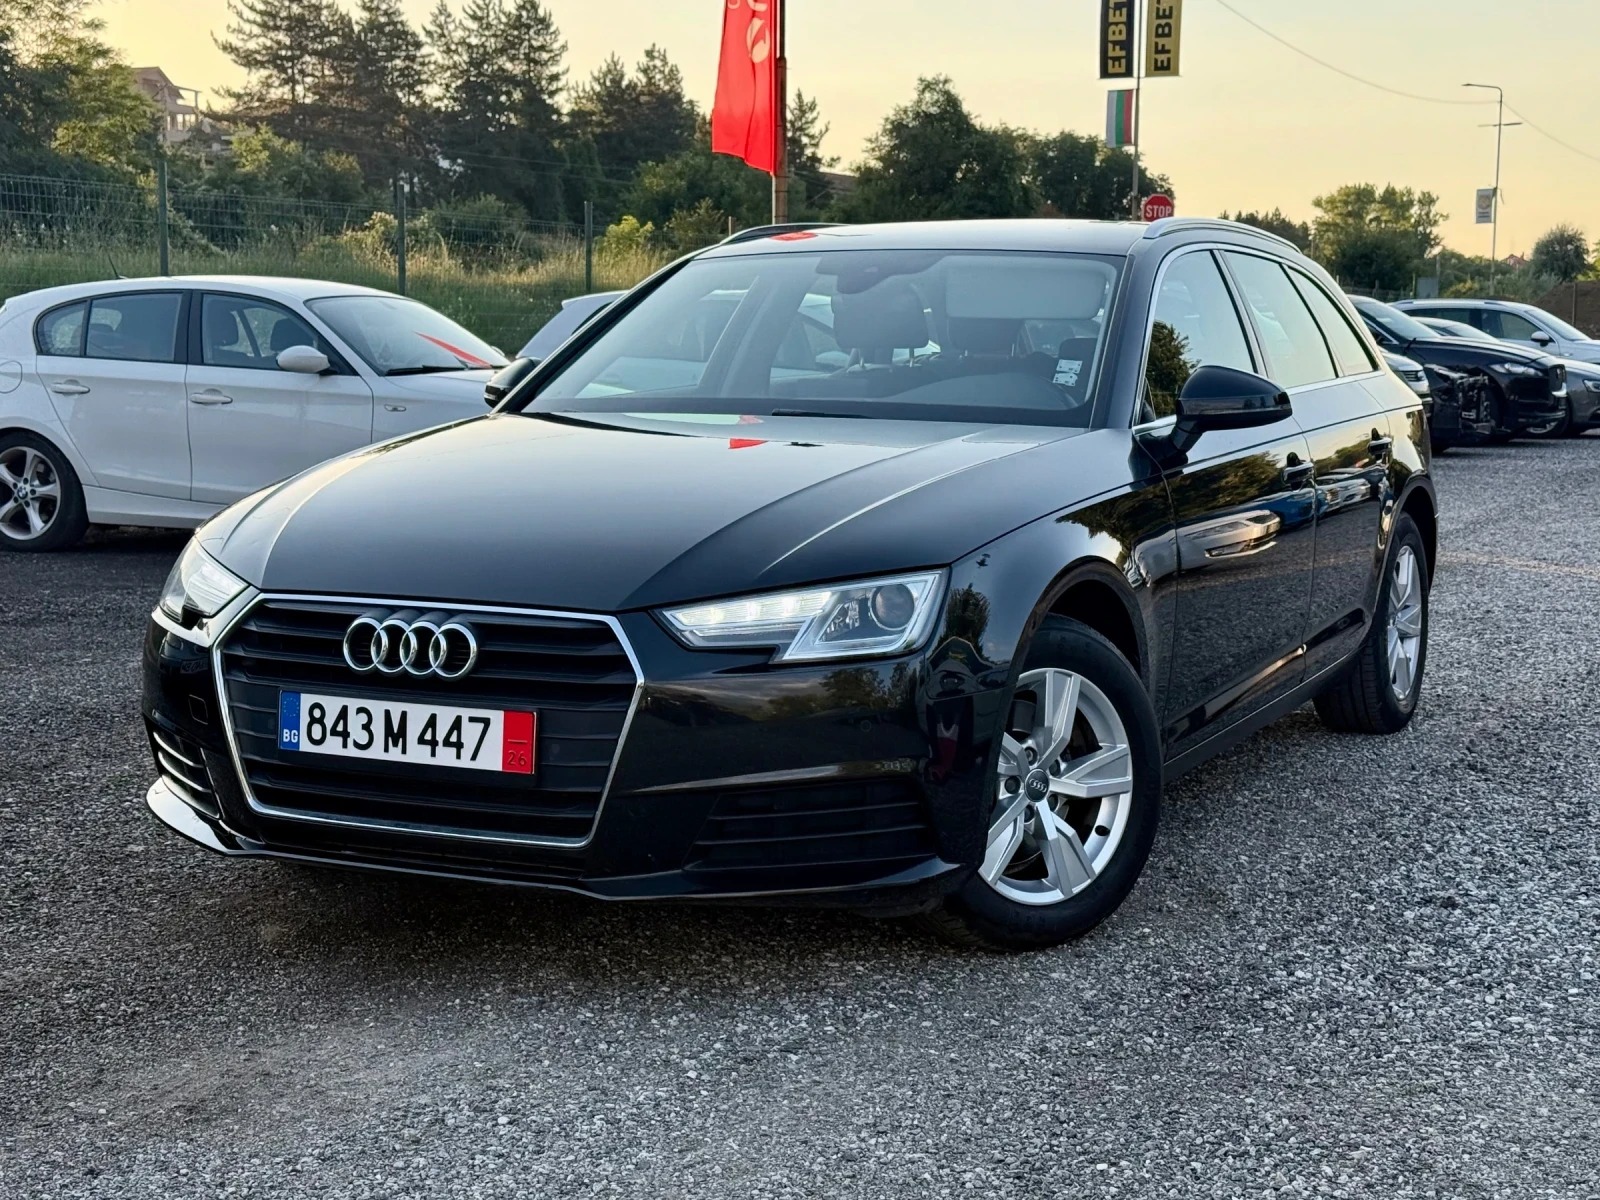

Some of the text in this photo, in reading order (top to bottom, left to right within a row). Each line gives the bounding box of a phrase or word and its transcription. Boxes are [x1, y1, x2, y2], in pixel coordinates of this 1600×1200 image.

[1153, 0, 1174, 72] EFBE
[1145, 204, 1172, 218] STOP
[282, 728, 299, 743] BG
[306, 702, 492, 762] 843 M 447
[507, 750, 527, 766] 26
